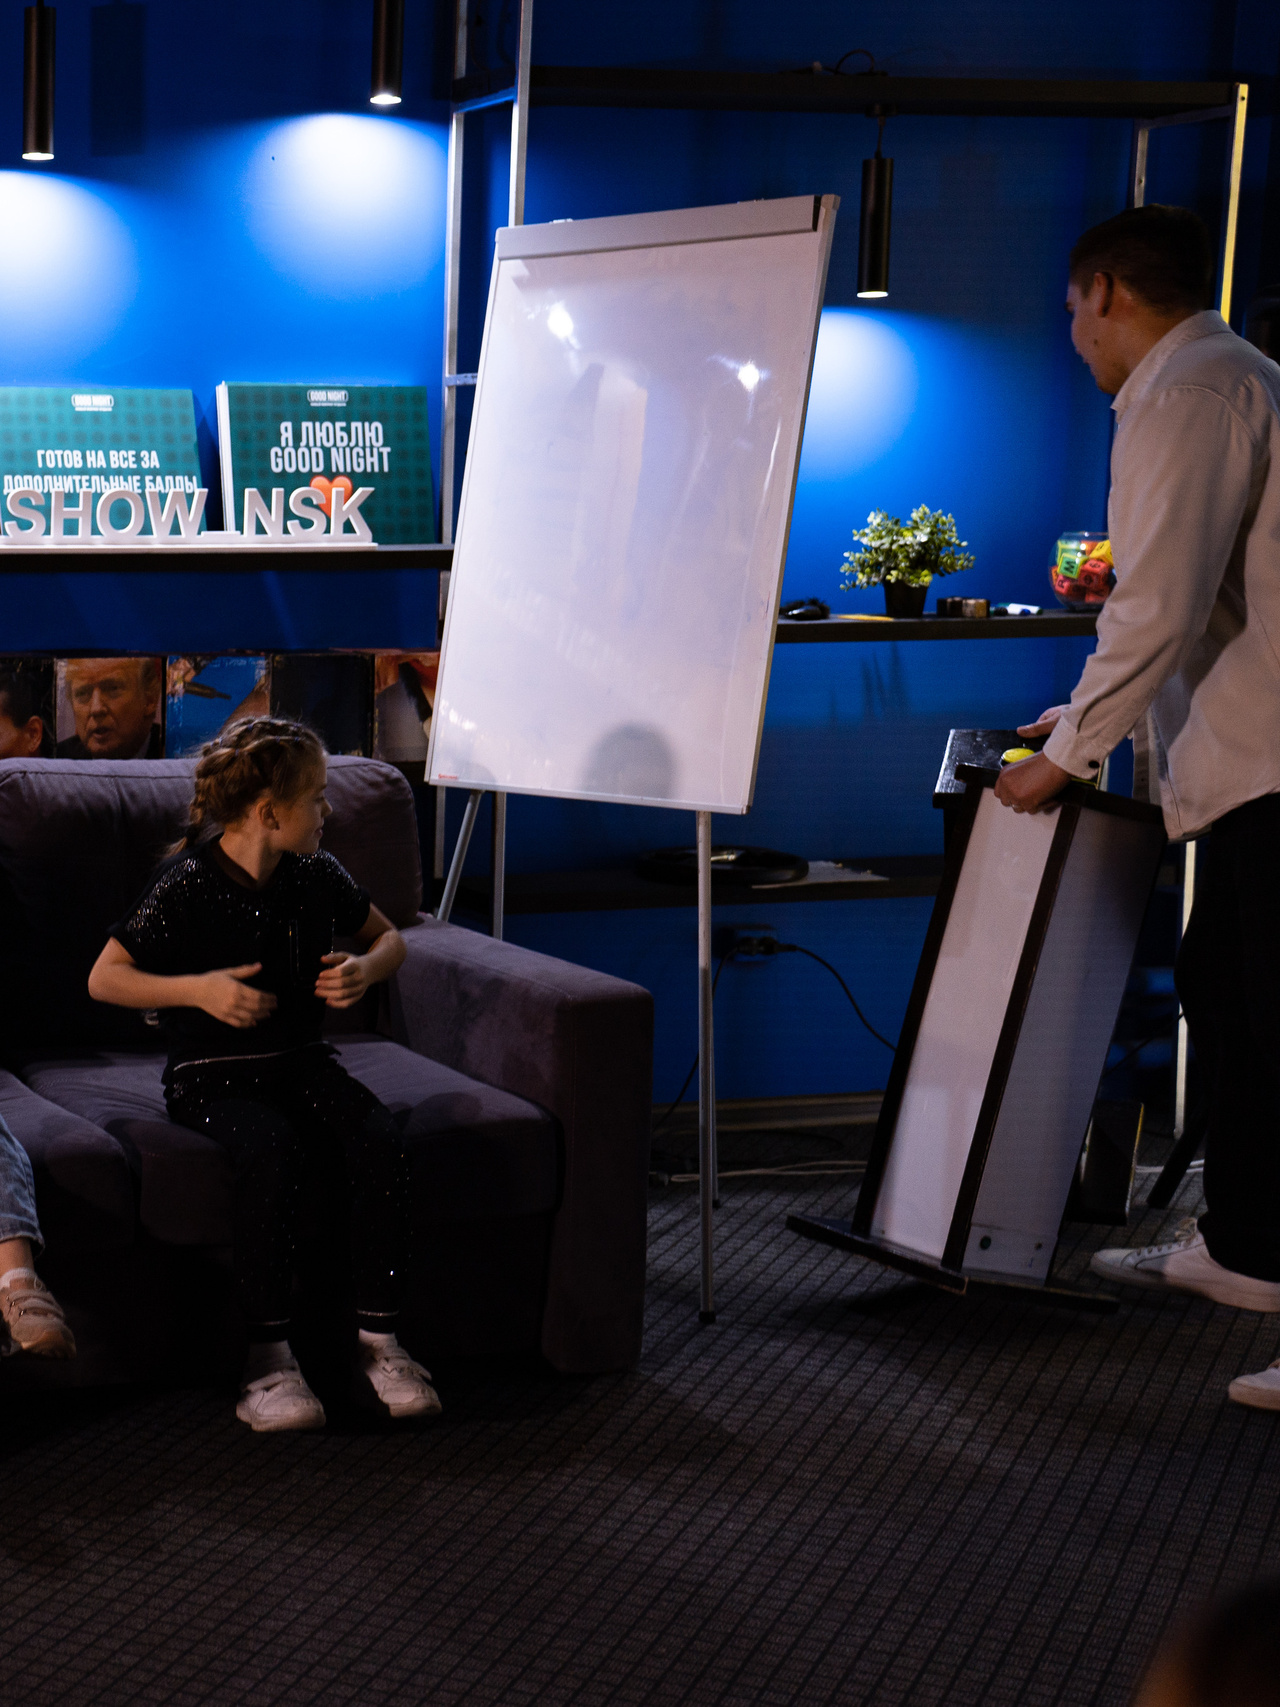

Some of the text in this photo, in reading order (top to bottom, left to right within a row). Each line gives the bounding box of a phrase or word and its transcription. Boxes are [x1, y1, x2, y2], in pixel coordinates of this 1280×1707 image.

[280, 421, 384, 447] Я ЛЮБЛЮ
[37, 449, 160, 469] ГОТОВ НА ВСЕ ЗА
[270, 446, 391, 473] GOOD NIGHT
[3, 474, 197, 495] ДОПОЛНИТЕЛЬНЫЕ БАЛЛЫ
